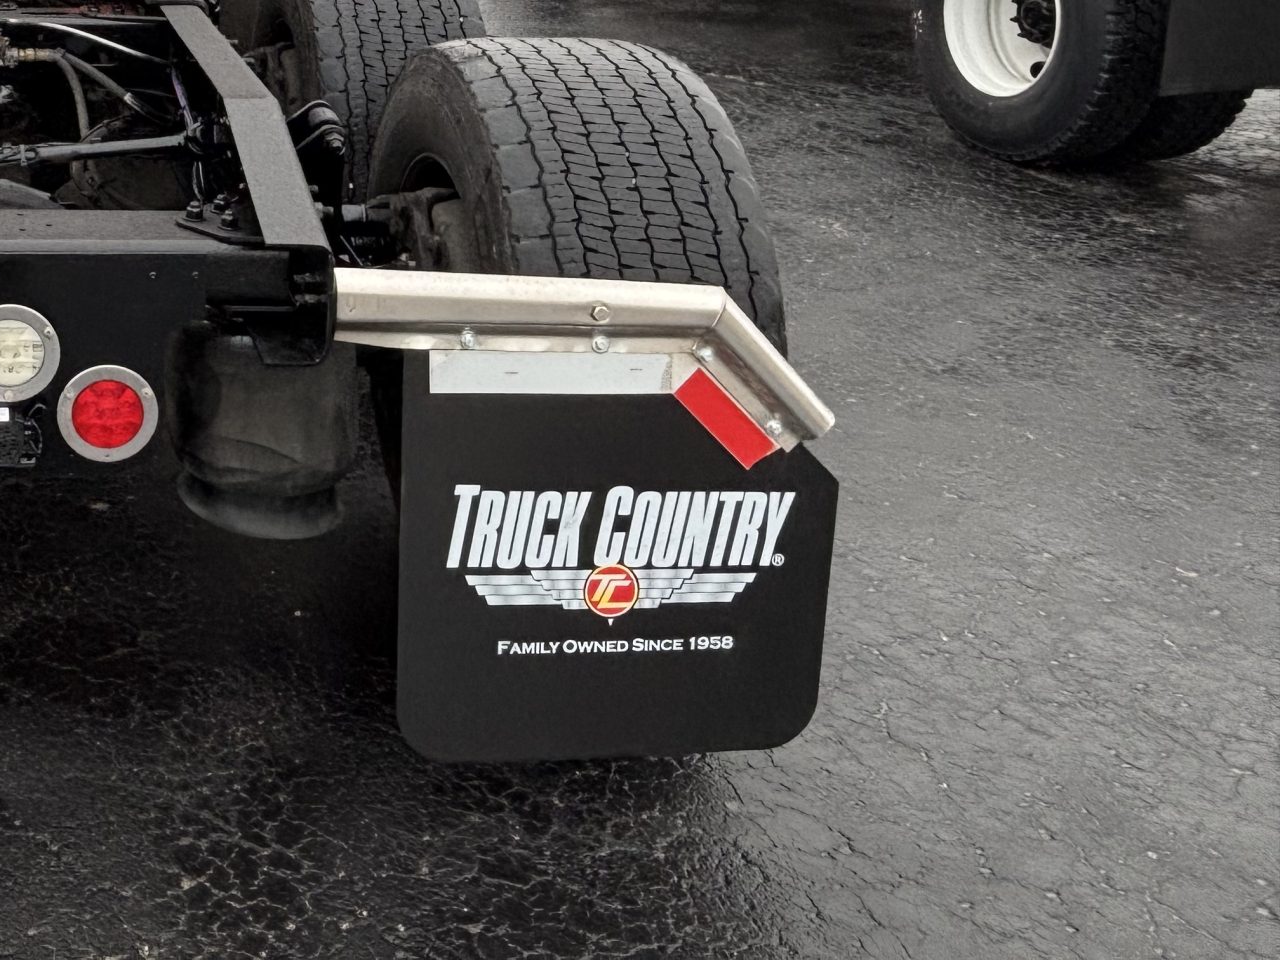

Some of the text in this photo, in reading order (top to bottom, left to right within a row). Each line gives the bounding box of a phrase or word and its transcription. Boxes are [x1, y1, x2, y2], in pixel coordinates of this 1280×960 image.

[446, 484, 593, 569] TRUCK
[497, 636, 734, 655] FAMILY OWNED SINCE 1958
